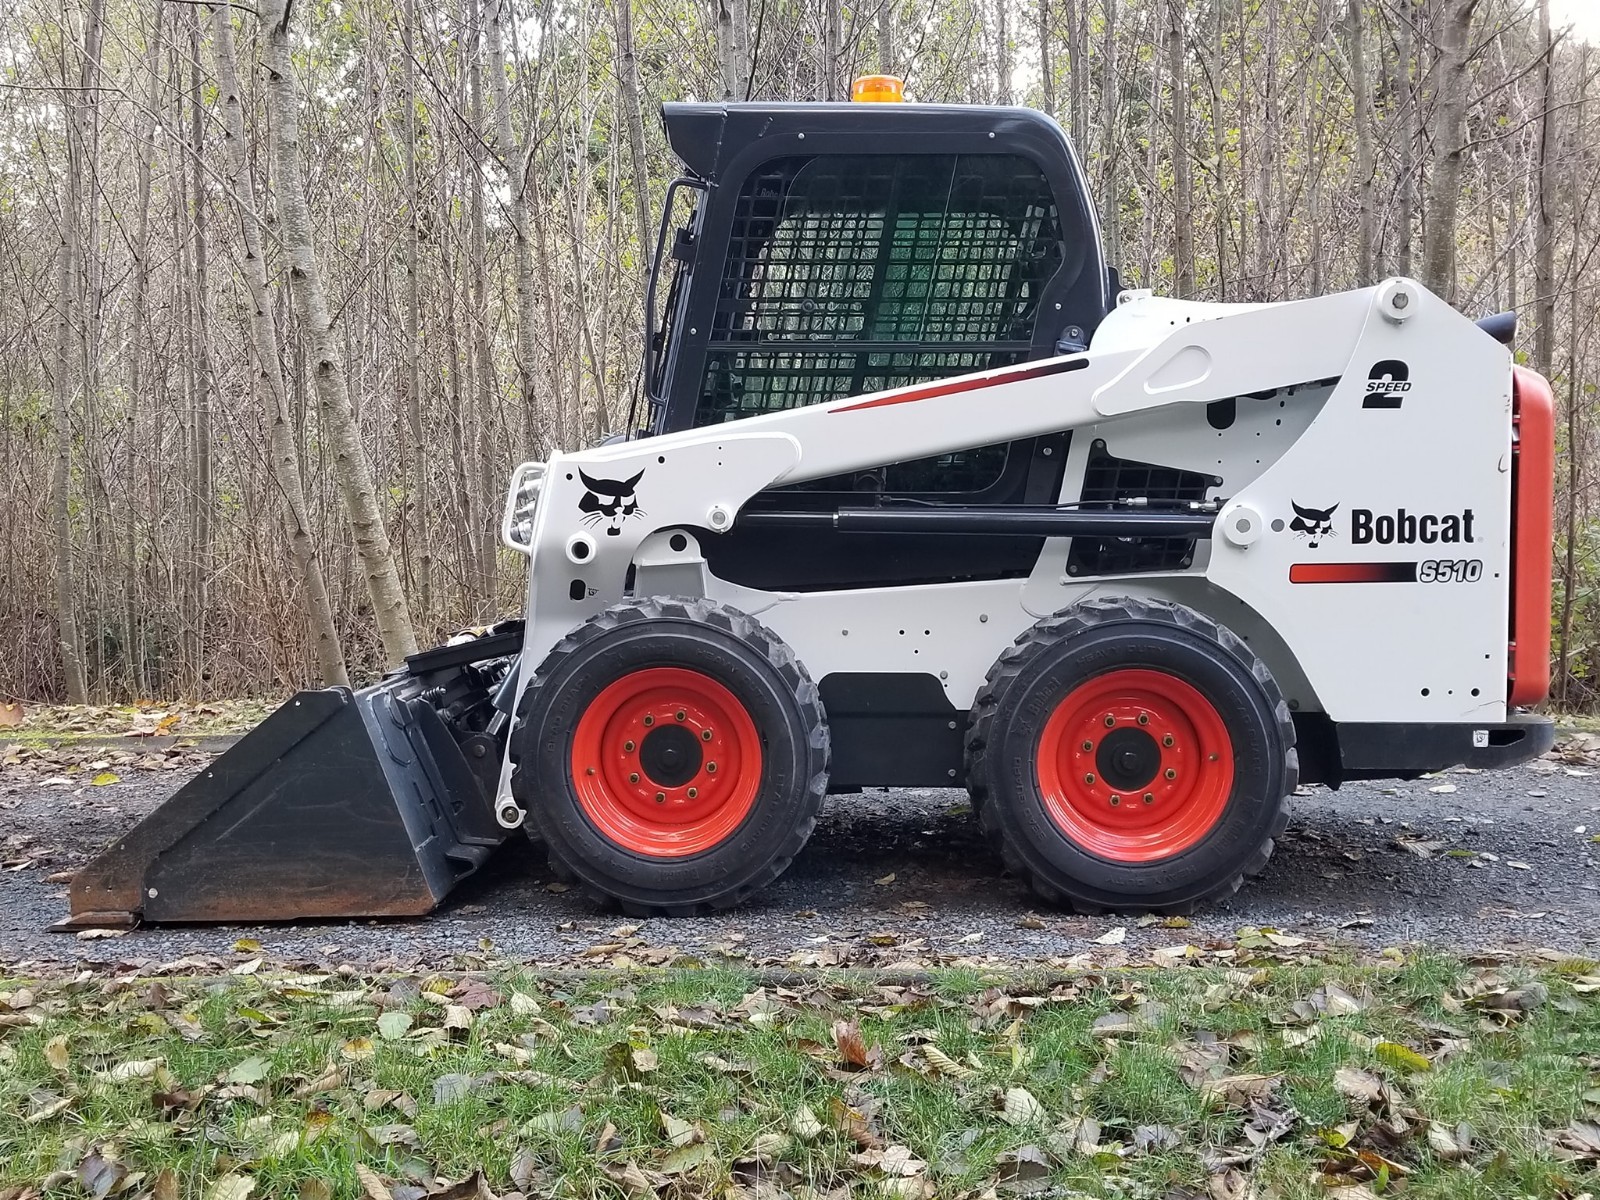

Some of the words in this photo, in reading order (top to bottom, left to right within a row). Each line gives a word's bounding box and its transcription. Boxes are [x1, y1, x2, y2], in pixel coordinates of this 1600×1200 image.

[1361, 359, 1410, 409] 2
[1366, 382, 1412, 392] SPEED
[1351, 508, 1475, 545] Bobcat
[1420, 559, 1483, 583] S510
